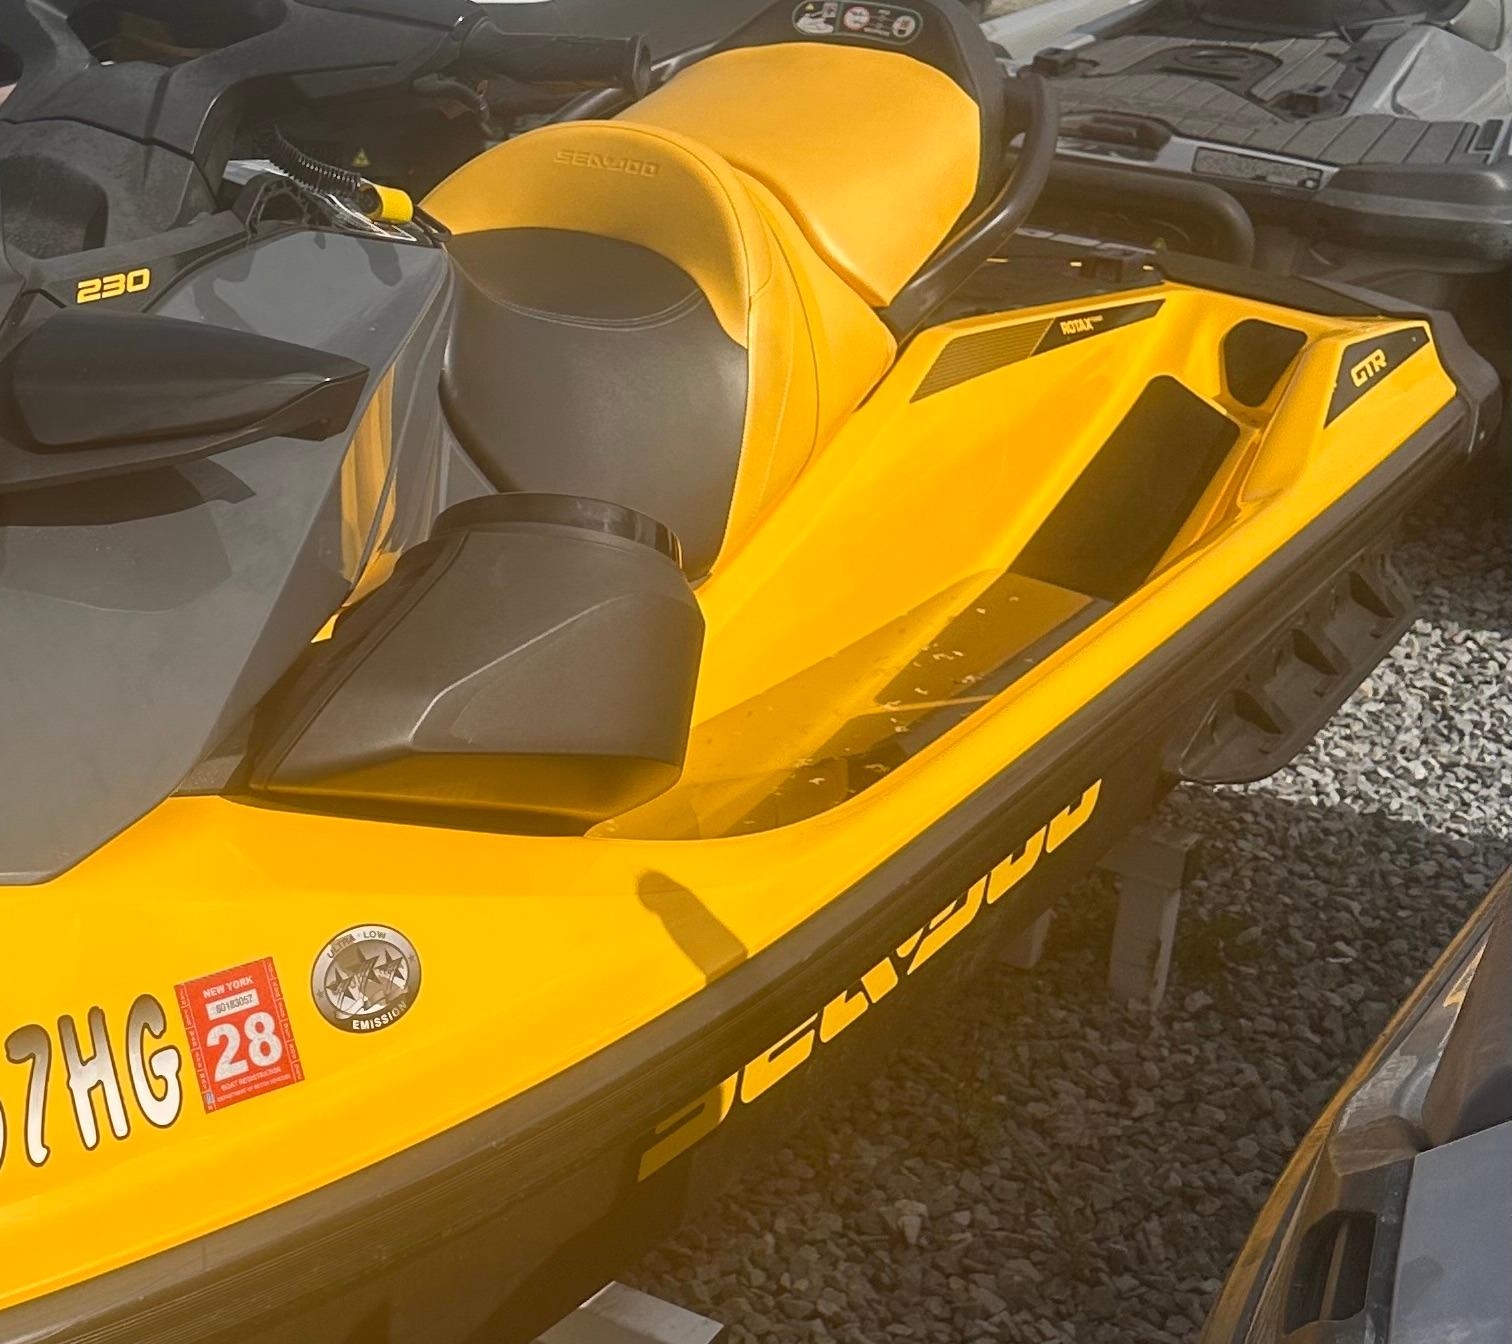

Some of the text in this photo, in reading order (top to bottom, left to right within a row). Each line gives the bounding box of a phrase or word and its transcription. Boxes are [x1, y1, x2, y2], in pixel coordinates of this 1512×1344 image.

[76, 268, 151, 304] 230
[1351, 349, 1387, 387] GTR
[363, 931, 386, 939] LOW
[202, 985, 226, 999] NEW
[225, 976, 254, 992] YORK
[352, 1000, 407, 1030] EMISSION
[206, 1011, 283, 1083] 28
